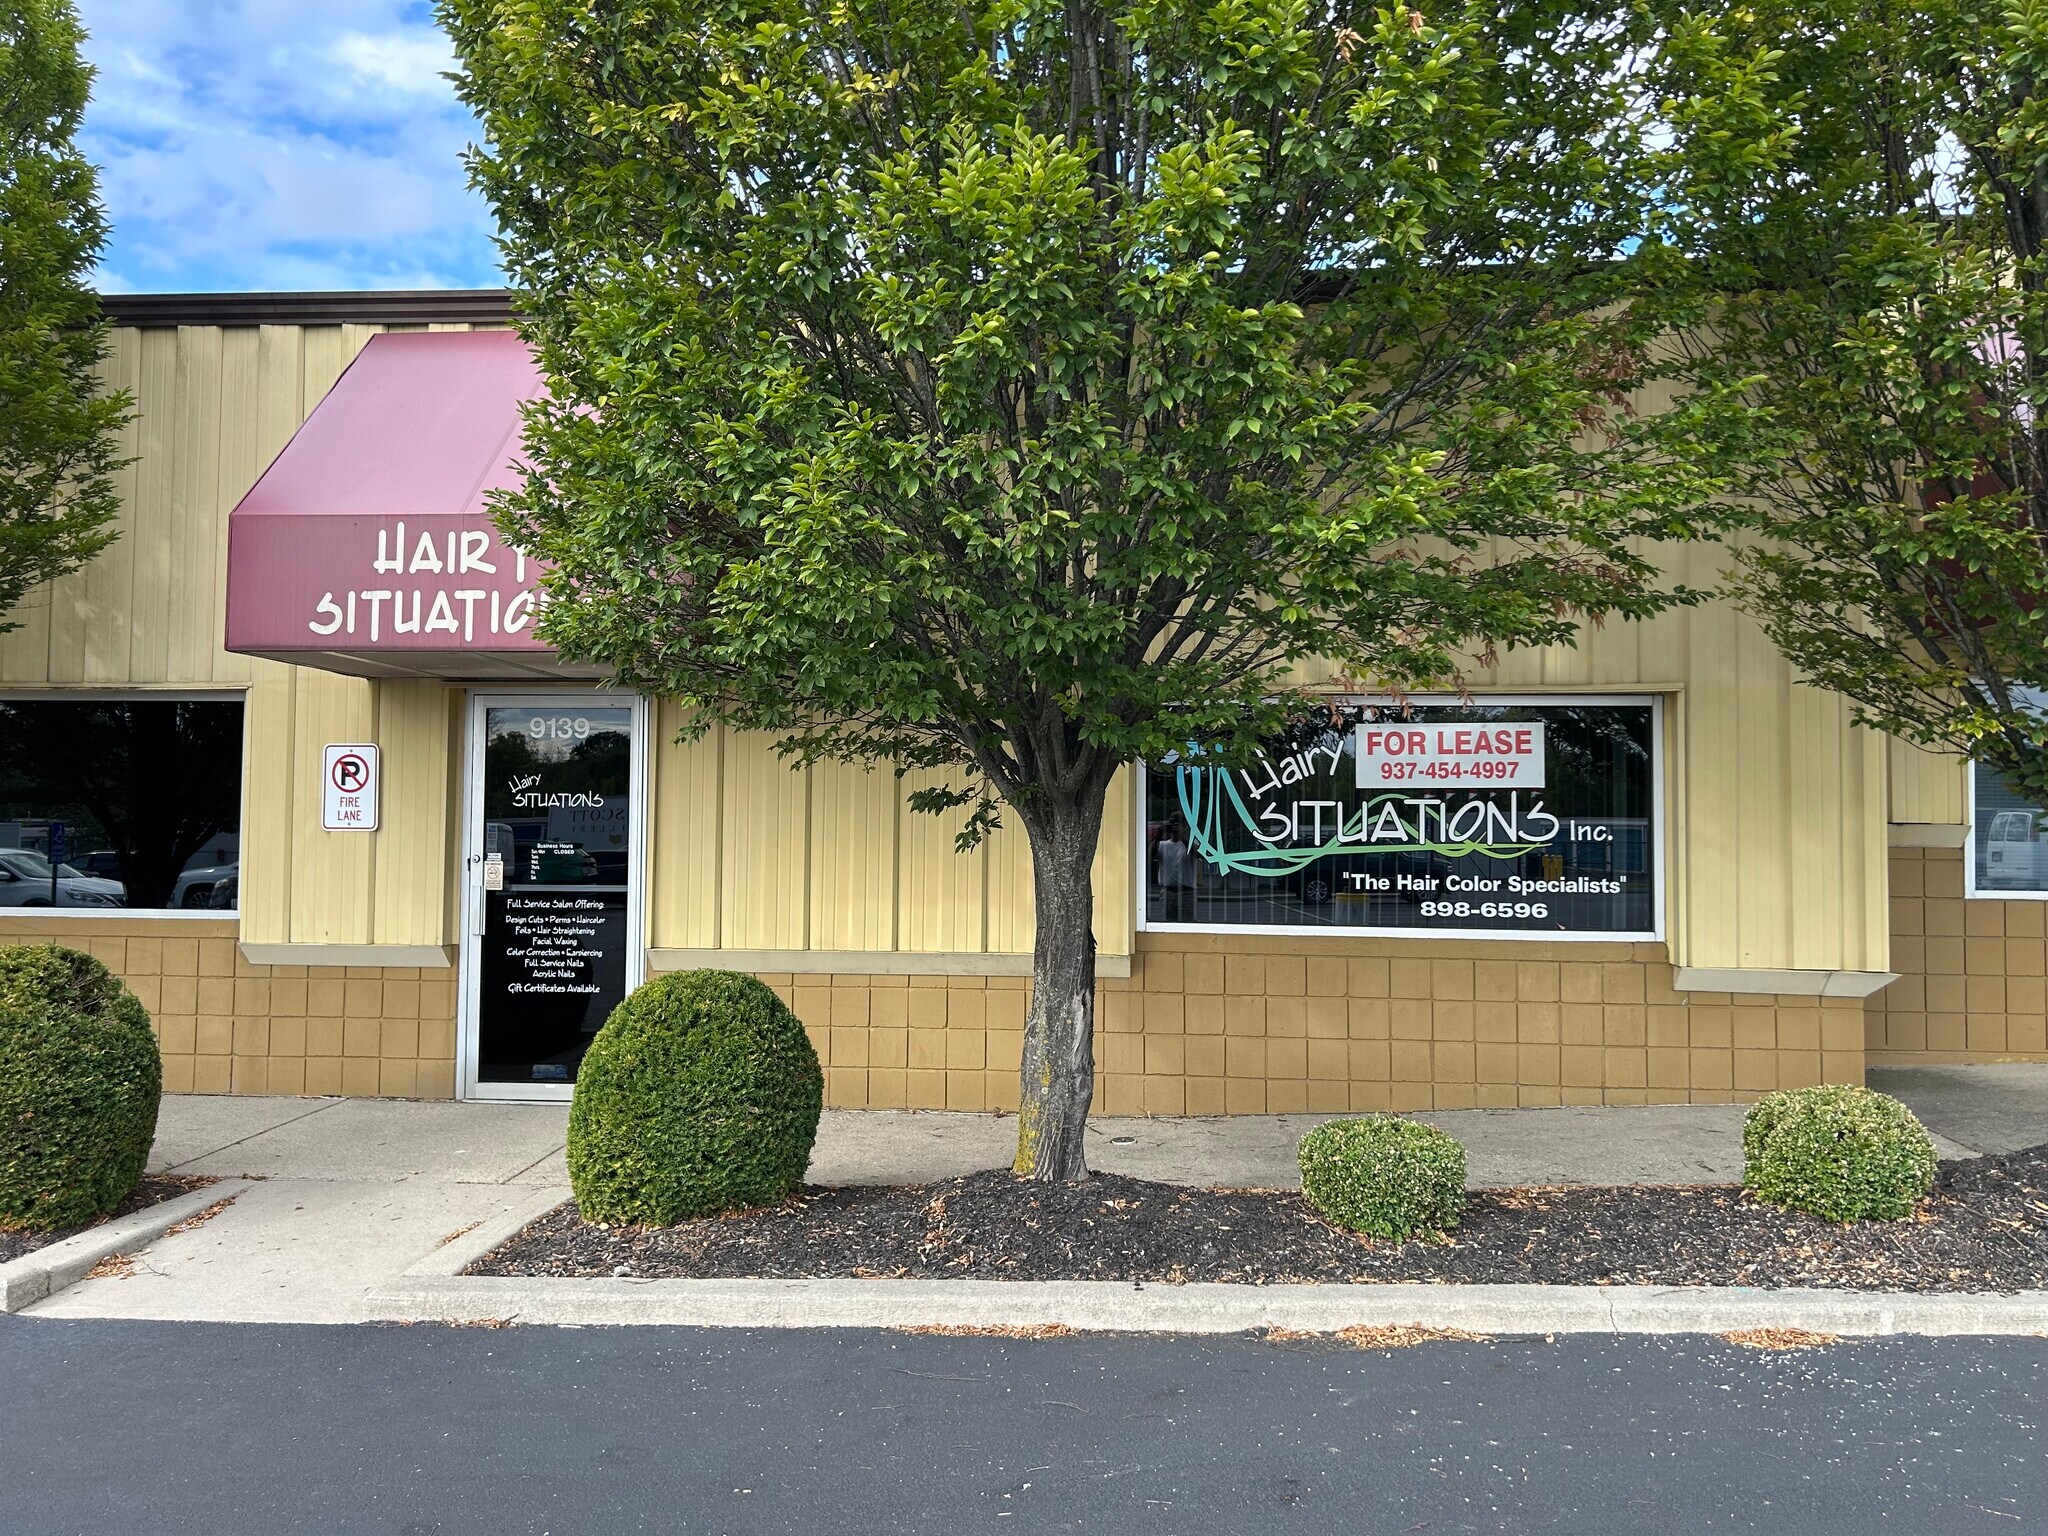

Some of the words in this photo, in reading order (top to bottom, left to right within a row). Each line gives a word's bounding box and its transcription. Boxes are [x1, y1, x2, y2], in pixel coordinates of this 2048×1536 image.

[309, 590, 593, 642] SITUATIO
[530, 717, 590, 739] 9139
[1367, 731, 1426, 756] FOR
[1437, 730, 1532, 755] LEASE
[1240, 740, 1345, 800] Hairy
[1380, 761, 1519, 780] 937-454-4997
[508, 773, 541, 794] Hairy
[340, 797, 360, 807] FIRE
[512, 790, 604, 809] SITUATIONS
[337, 810, 362, 821] LANE
[1252, 790, 1560, 847] SITUATIONS
[1569, 819, 1614, 842] Inc.
[1342, 872, 1391, 891] "The
[1397, 874, 1439, 892] Hair
[1445, 875, 1502, 893] Color
[1508, 875, 1627, 896] Specialists"
[507, 899, 522, 909] Full
[523, 899, 551, 909] Service
[551, 899, 574, 909] Salon
[1420, 901, 1549, 919] 898-6596
[505, 915, 527, 924] Design
[528, 915, 544, 924] Cuts
[549, 915, 571, 924] Perms
[576, 915, 606, 924] Haircolor
[515, 926, 532, 936] Foils
[537, 925, 551, 935] Hair
[551, 926, 596, 936] Straightening
[532, 936, 553, 947] Facial
[553, 936, 578, 947] Waxing
[506, 947, 526, 956] Color
[526, 947, 561, 957] Correction
[524, 958, 539, 968] Full
[540, 958, 565, 967] Service
[566, 958, 585, 968] Nails
[532, 969, 557, 979] Acrylic
[557, 968, 576, 978] Nails
[507, 983, 523, 994] Gift
[523, 983, 566, 993] Certificates
[566, 983, 600, 993] Available
